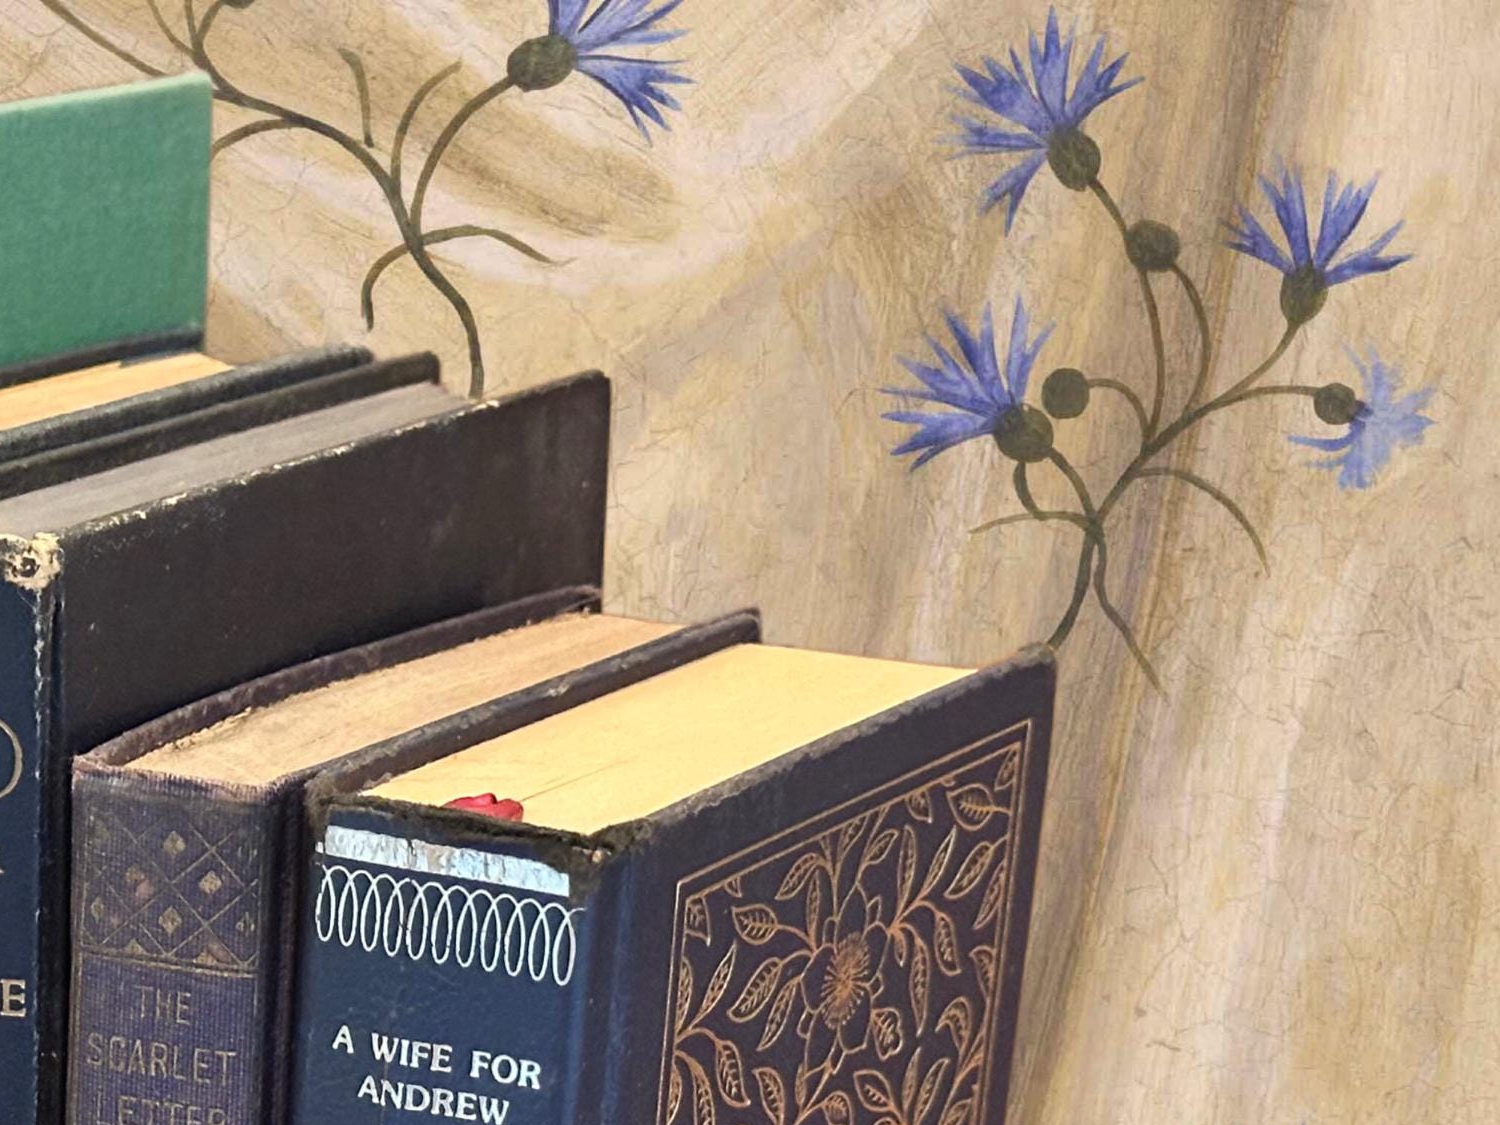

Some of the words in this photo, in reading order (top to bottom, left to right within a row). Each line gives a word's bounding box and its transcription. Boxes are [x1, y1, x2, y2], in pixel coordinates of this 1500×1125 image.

[134, 985, 191, 1025] THE
[87, 1033, 237, 1087] SCARLET
[332, 1025, 355, 1053] A
[371, 1033, 453, 1072] WIFE
[469, 1051, 541, 1090] FOR
[357, 1075, 509, 1125] ANDREW
